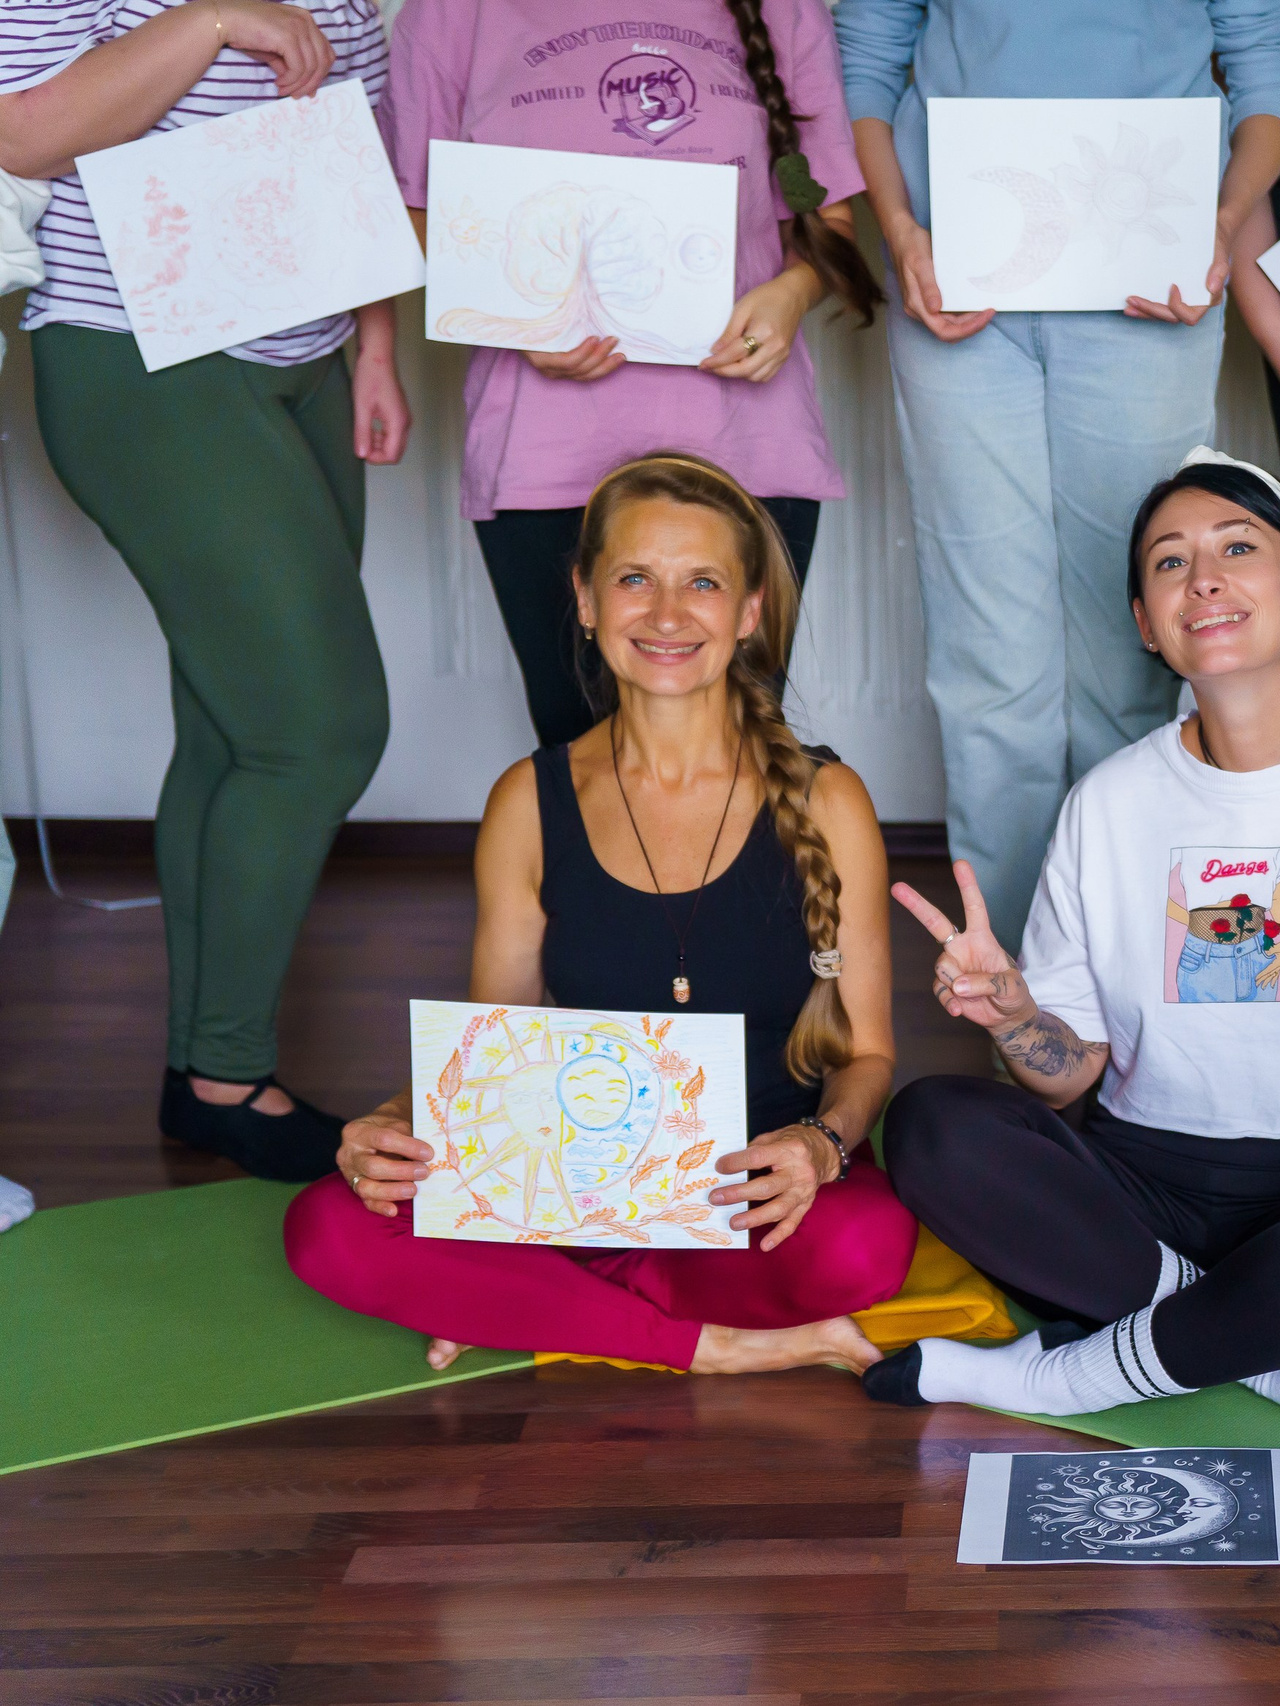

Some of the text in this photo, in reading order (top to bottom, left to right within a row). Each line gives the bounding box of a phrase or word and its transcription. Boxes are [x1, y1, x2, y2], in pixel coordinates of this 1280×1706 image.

[523, 28, 590, 68] ENJOY
[606, 67, 684, 98] MUSIC
[511, 86, 585, 108] UNLIMITED
[1200, 859, 1270, 883] Danger
